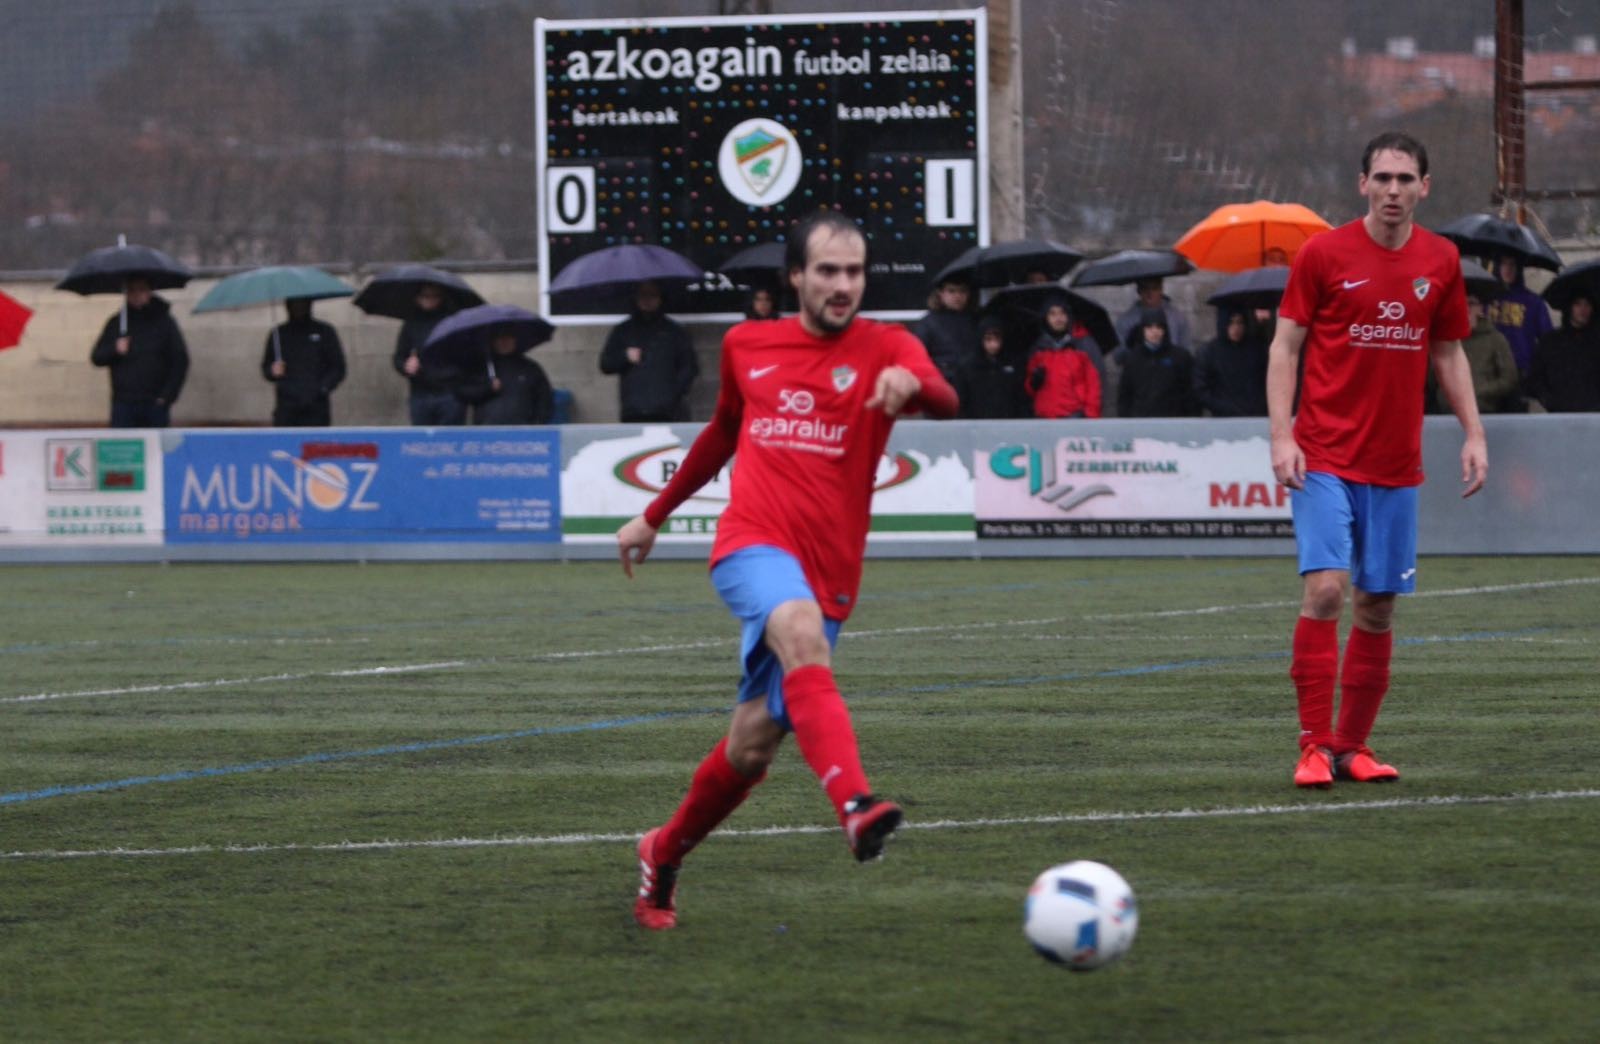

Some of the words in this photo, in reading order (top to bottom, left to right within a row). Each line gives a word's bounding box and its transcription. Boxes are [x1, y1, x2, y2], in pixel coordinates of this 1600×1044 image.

[567, 37, 781, 92] azkoagain
[793, 49, 870, 76] futbol
[880, 48, 951, 74] zelaia
[572, 107, 680, 127] bertakoak
[837, 103, 952, 123] kanpokoak
[555, 174, 587, 226] 0
[1349, 322, 1427, 342] egaralur
[750, 417, 848, 442] egaralur
[1065, 460, 1179, 474] ZERBITZUAK
[179, 509, 303, 538] margoak
